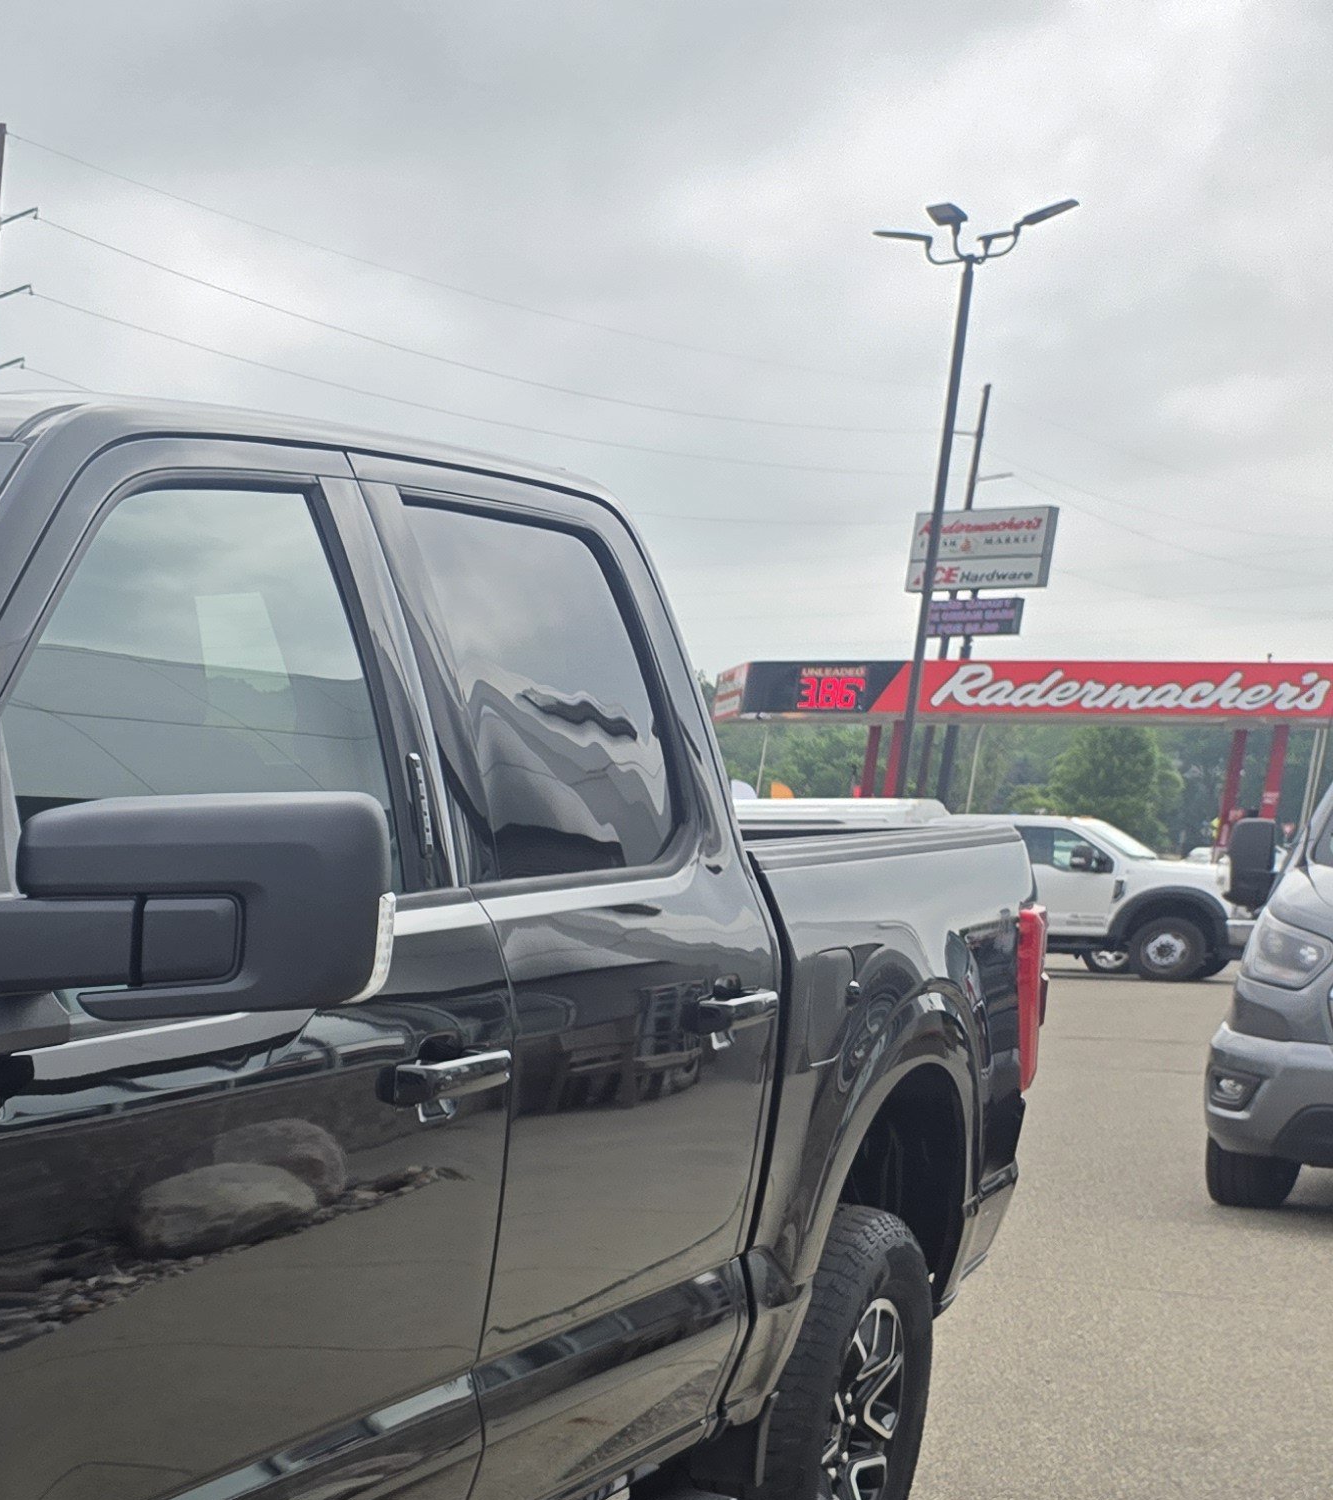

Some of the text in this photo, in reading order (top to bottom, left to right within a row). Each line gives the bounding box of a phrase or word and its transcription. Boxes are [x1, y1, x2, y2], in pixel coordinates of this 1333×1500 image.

[959, 569, 1033, 583] Hardware
[802, 667, 865, 676] UNLEADED
[930, 663, 1331, 711] Radermacher's
